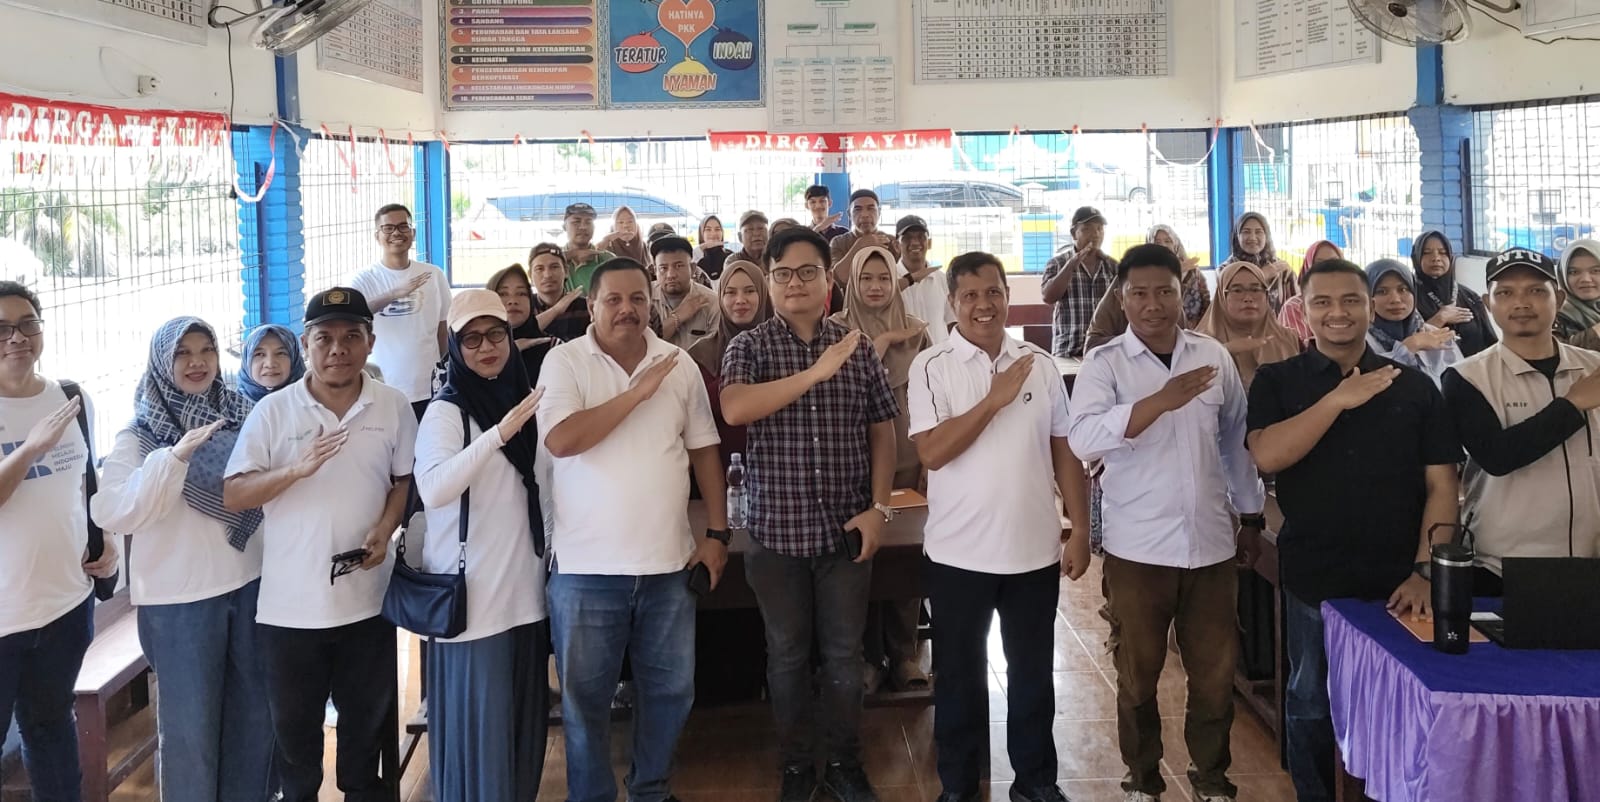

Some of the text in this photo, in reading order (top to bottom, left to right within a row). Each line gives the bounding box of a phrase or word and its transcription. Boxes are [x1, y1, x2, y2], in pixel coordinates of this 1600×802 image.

[668, 10, 704, 20] HATINYA
[677, 24, 696, 33] PKK
[615, 47, 667, 64] TERATUR
[714, 42, 752, 59] INDAH
[663, 73, 717, 91] NYAMAN
[745, 133, 918, 149] DIRGA HAYU
[1496, 254, 1542, 266] NTU
[55, 463, 72, 472] MAJU
